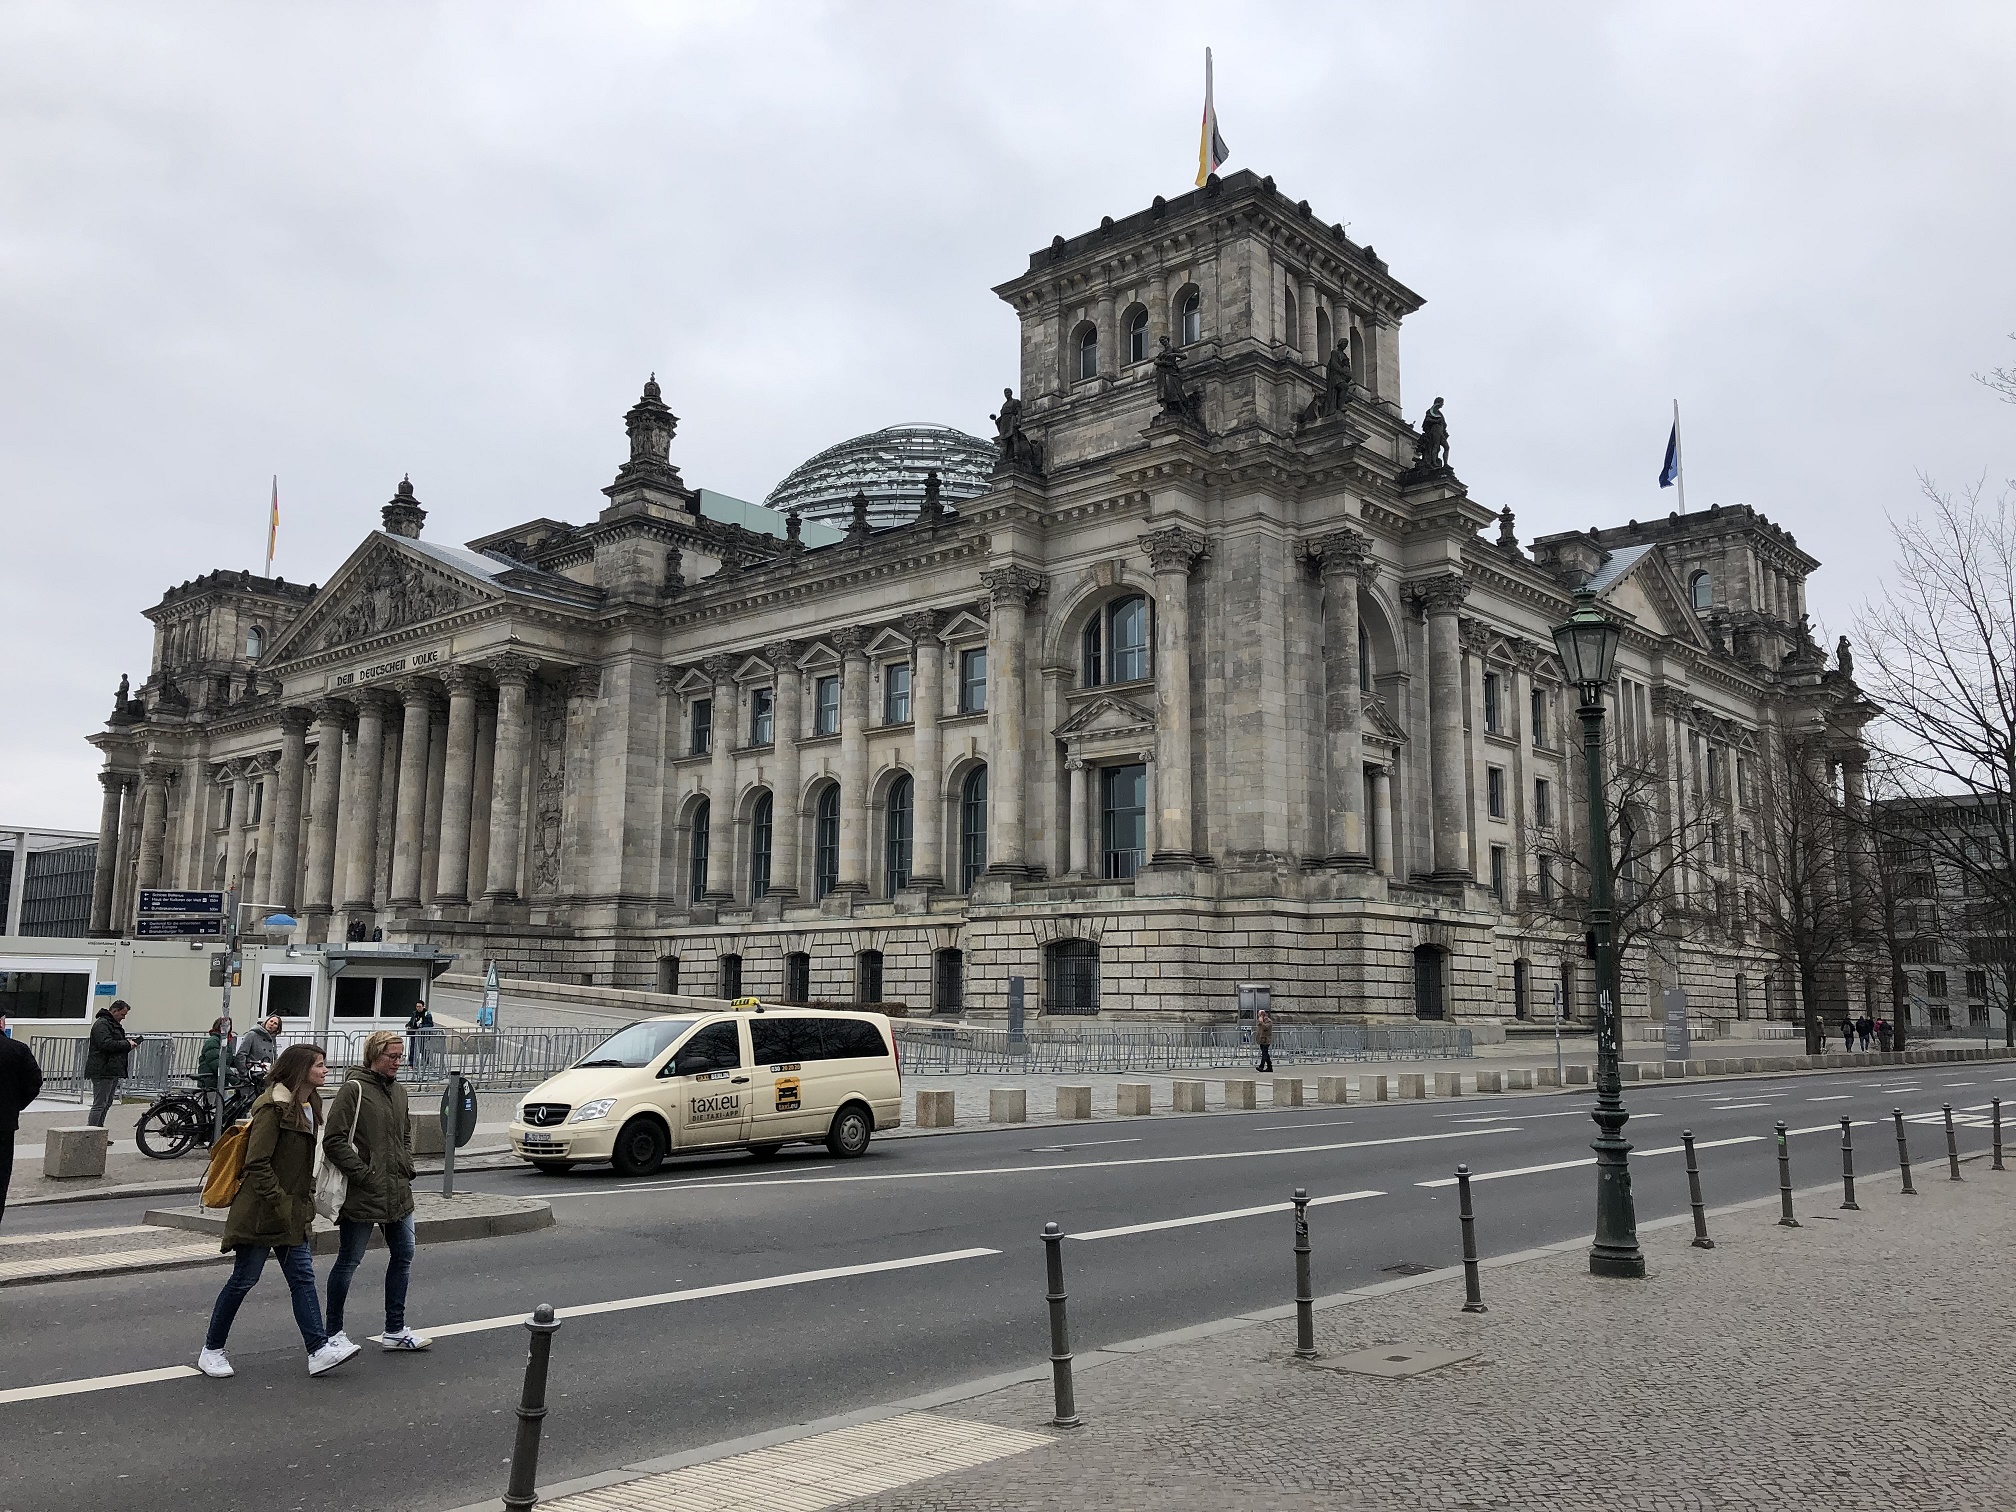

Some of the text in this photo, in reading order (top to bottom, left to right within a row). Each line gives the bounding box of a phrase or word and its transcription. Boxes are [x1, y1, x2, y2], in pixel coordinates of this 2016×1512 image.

[337, 650, 438, 686] DEM DEUTSCHEN VOLKE
[731, 998, 750, 1006] TAXI
[697, 1072, 730, 1082] TAXI BERLIN
[691, 1093, 739, 1114] taxi.eu
[778, 1102, 799, 1110] taxi.eu
[707, 1110, 739, 1120] TAXI-APP
